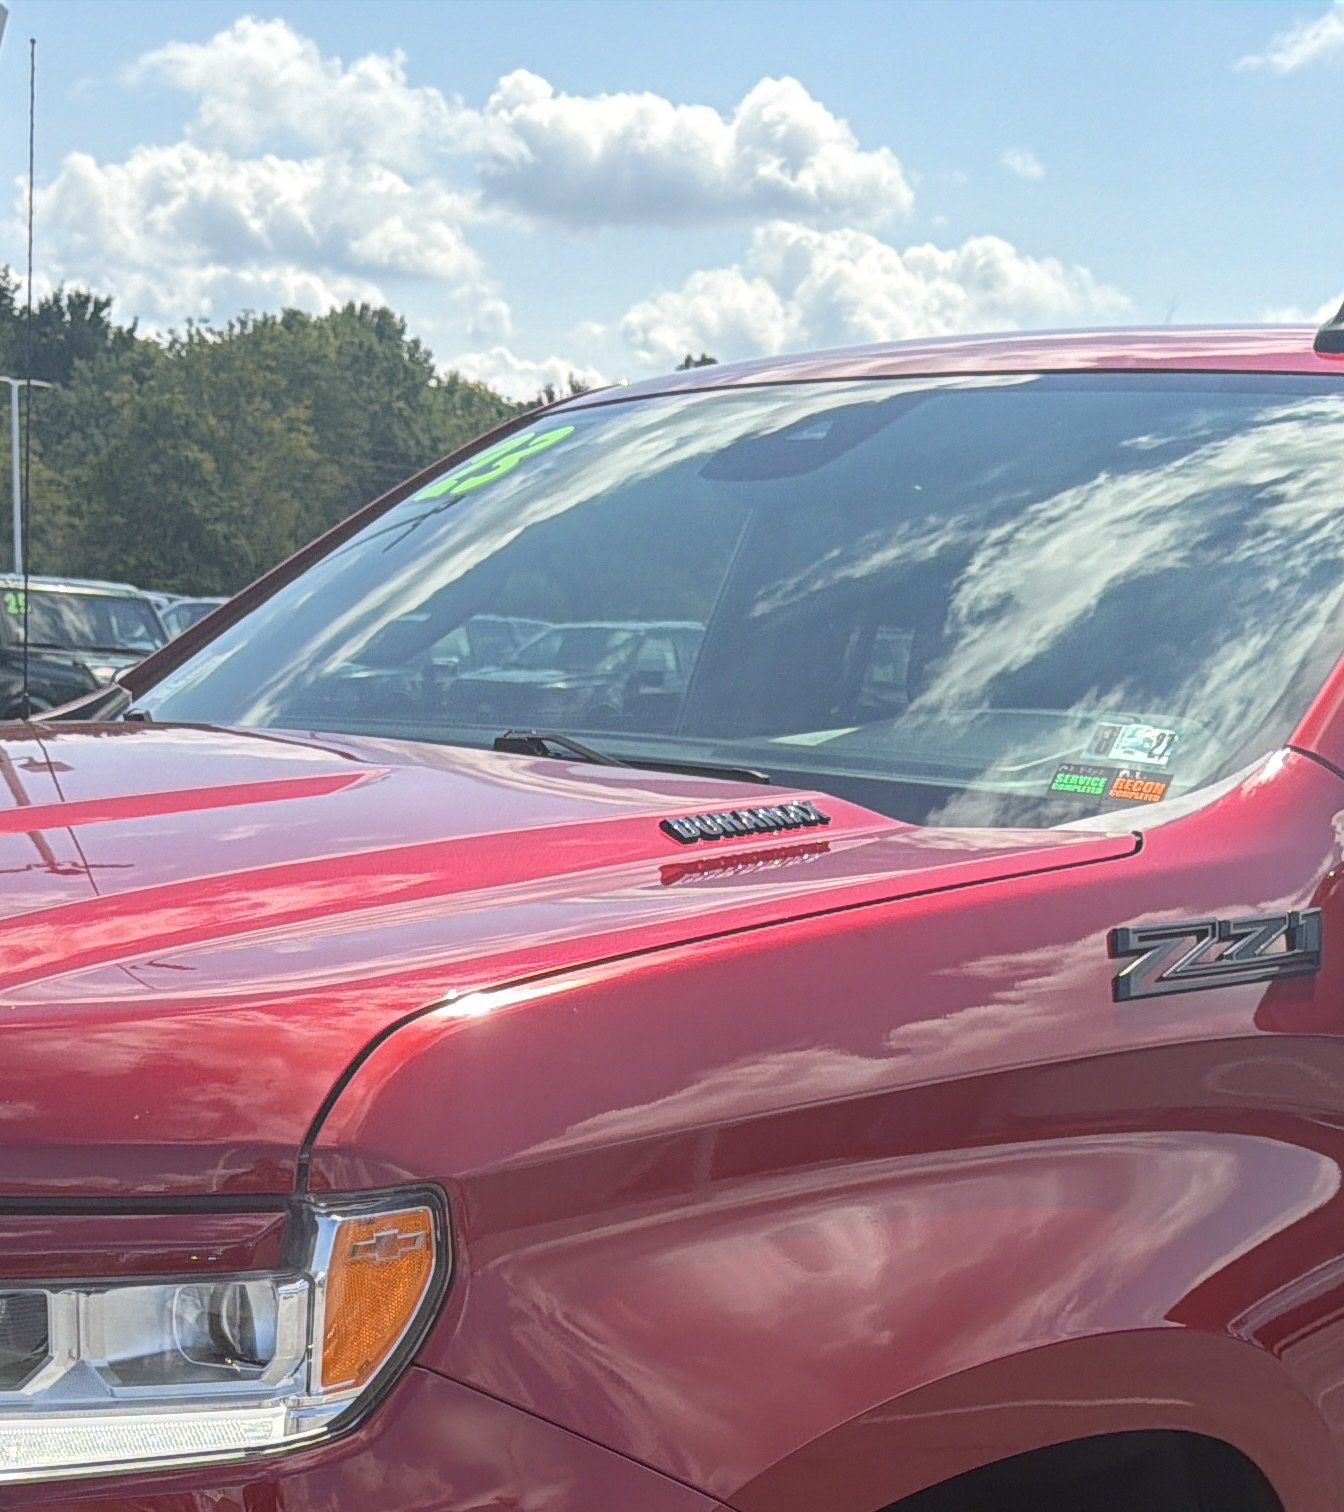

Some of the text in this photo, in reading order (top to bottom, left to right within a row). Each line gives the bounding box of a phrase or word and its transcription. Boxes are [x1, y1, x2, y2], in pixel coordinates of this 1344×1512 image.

[413, 426, 575, 502] 23
[1054, 773, 1108, 788] SERVICE
[1113, 777, 1167, 795] RECON
[664, 800, 831, 842] DURAMAX
[1108, 907, 1323, 1002] Z71
